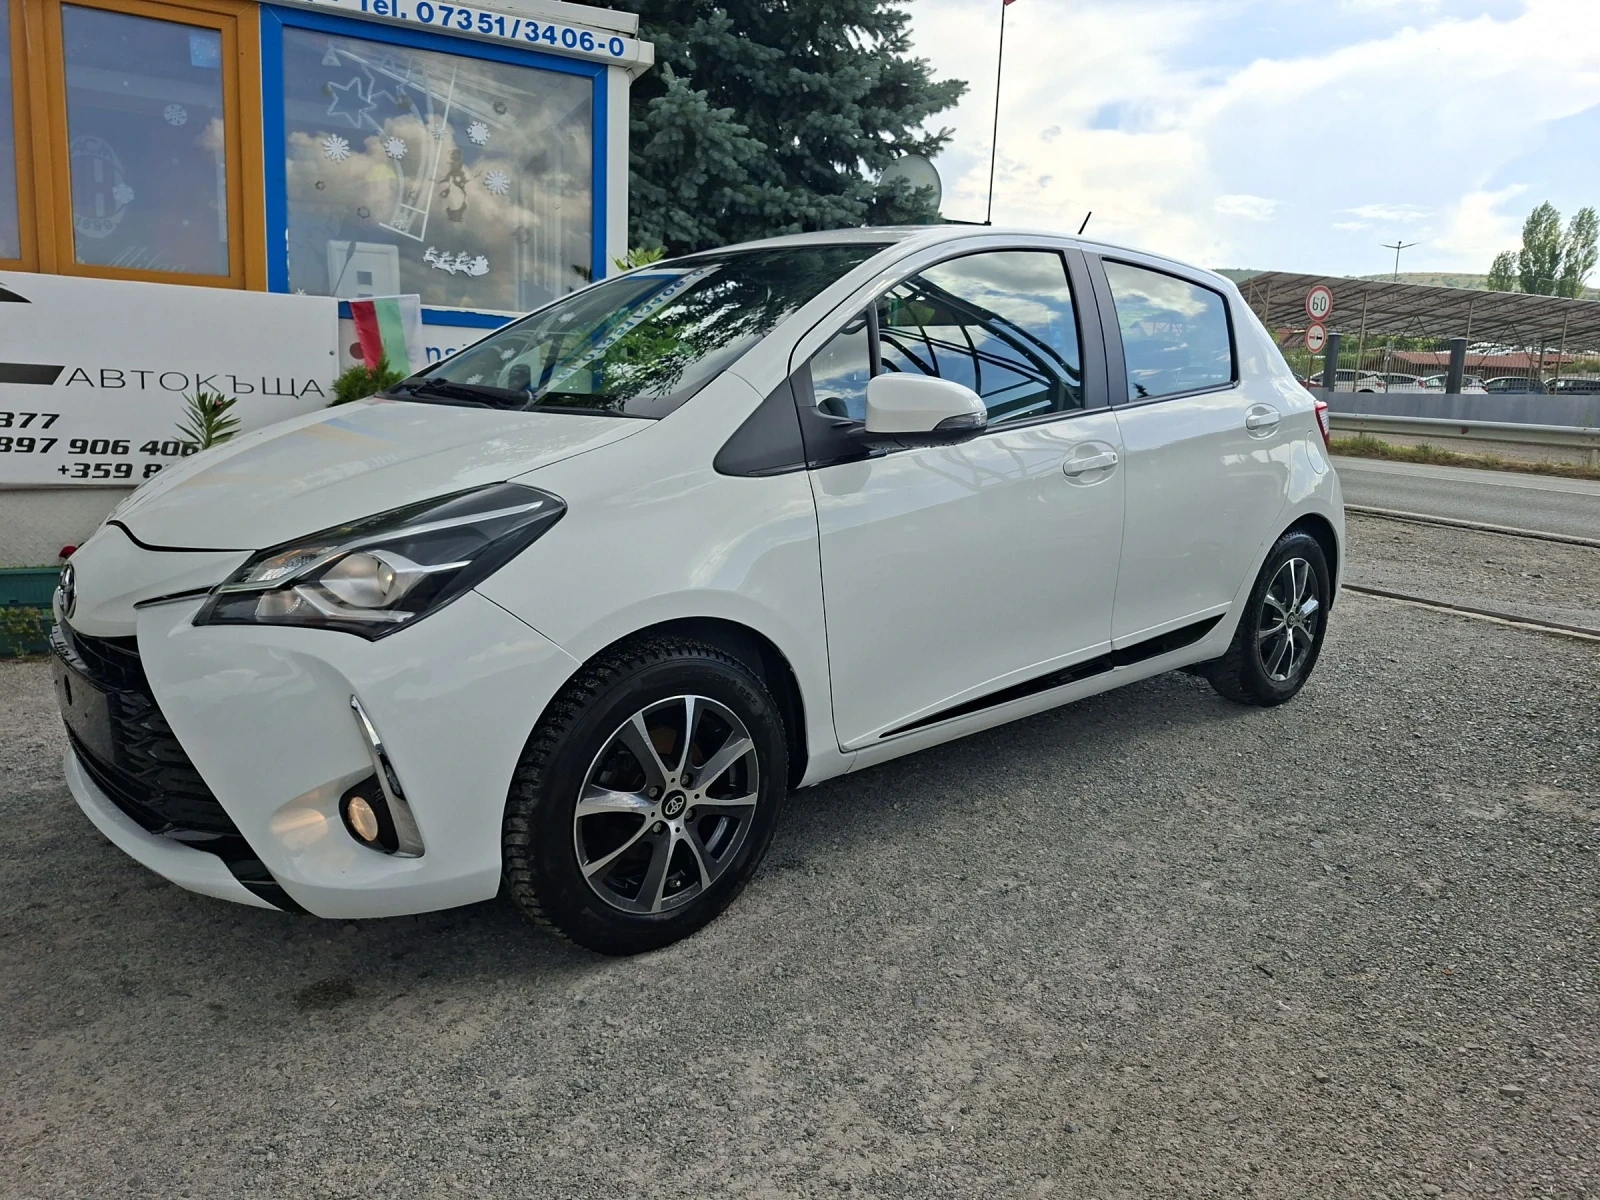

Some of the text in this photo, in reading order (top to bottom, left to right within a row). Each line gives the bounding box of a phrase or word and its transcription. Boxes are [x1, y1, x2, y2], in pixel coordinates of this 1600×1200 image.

[416, 1, 625, 57] 07351/3406-0
[1312, 296, 1327, 312] 60
[65, 367, 326, 400] АВТОКЪЩА
[0, 436, 59, 453] 897
[68, 438, 131, 455] 906
[58, 462, 134, 479] +359
